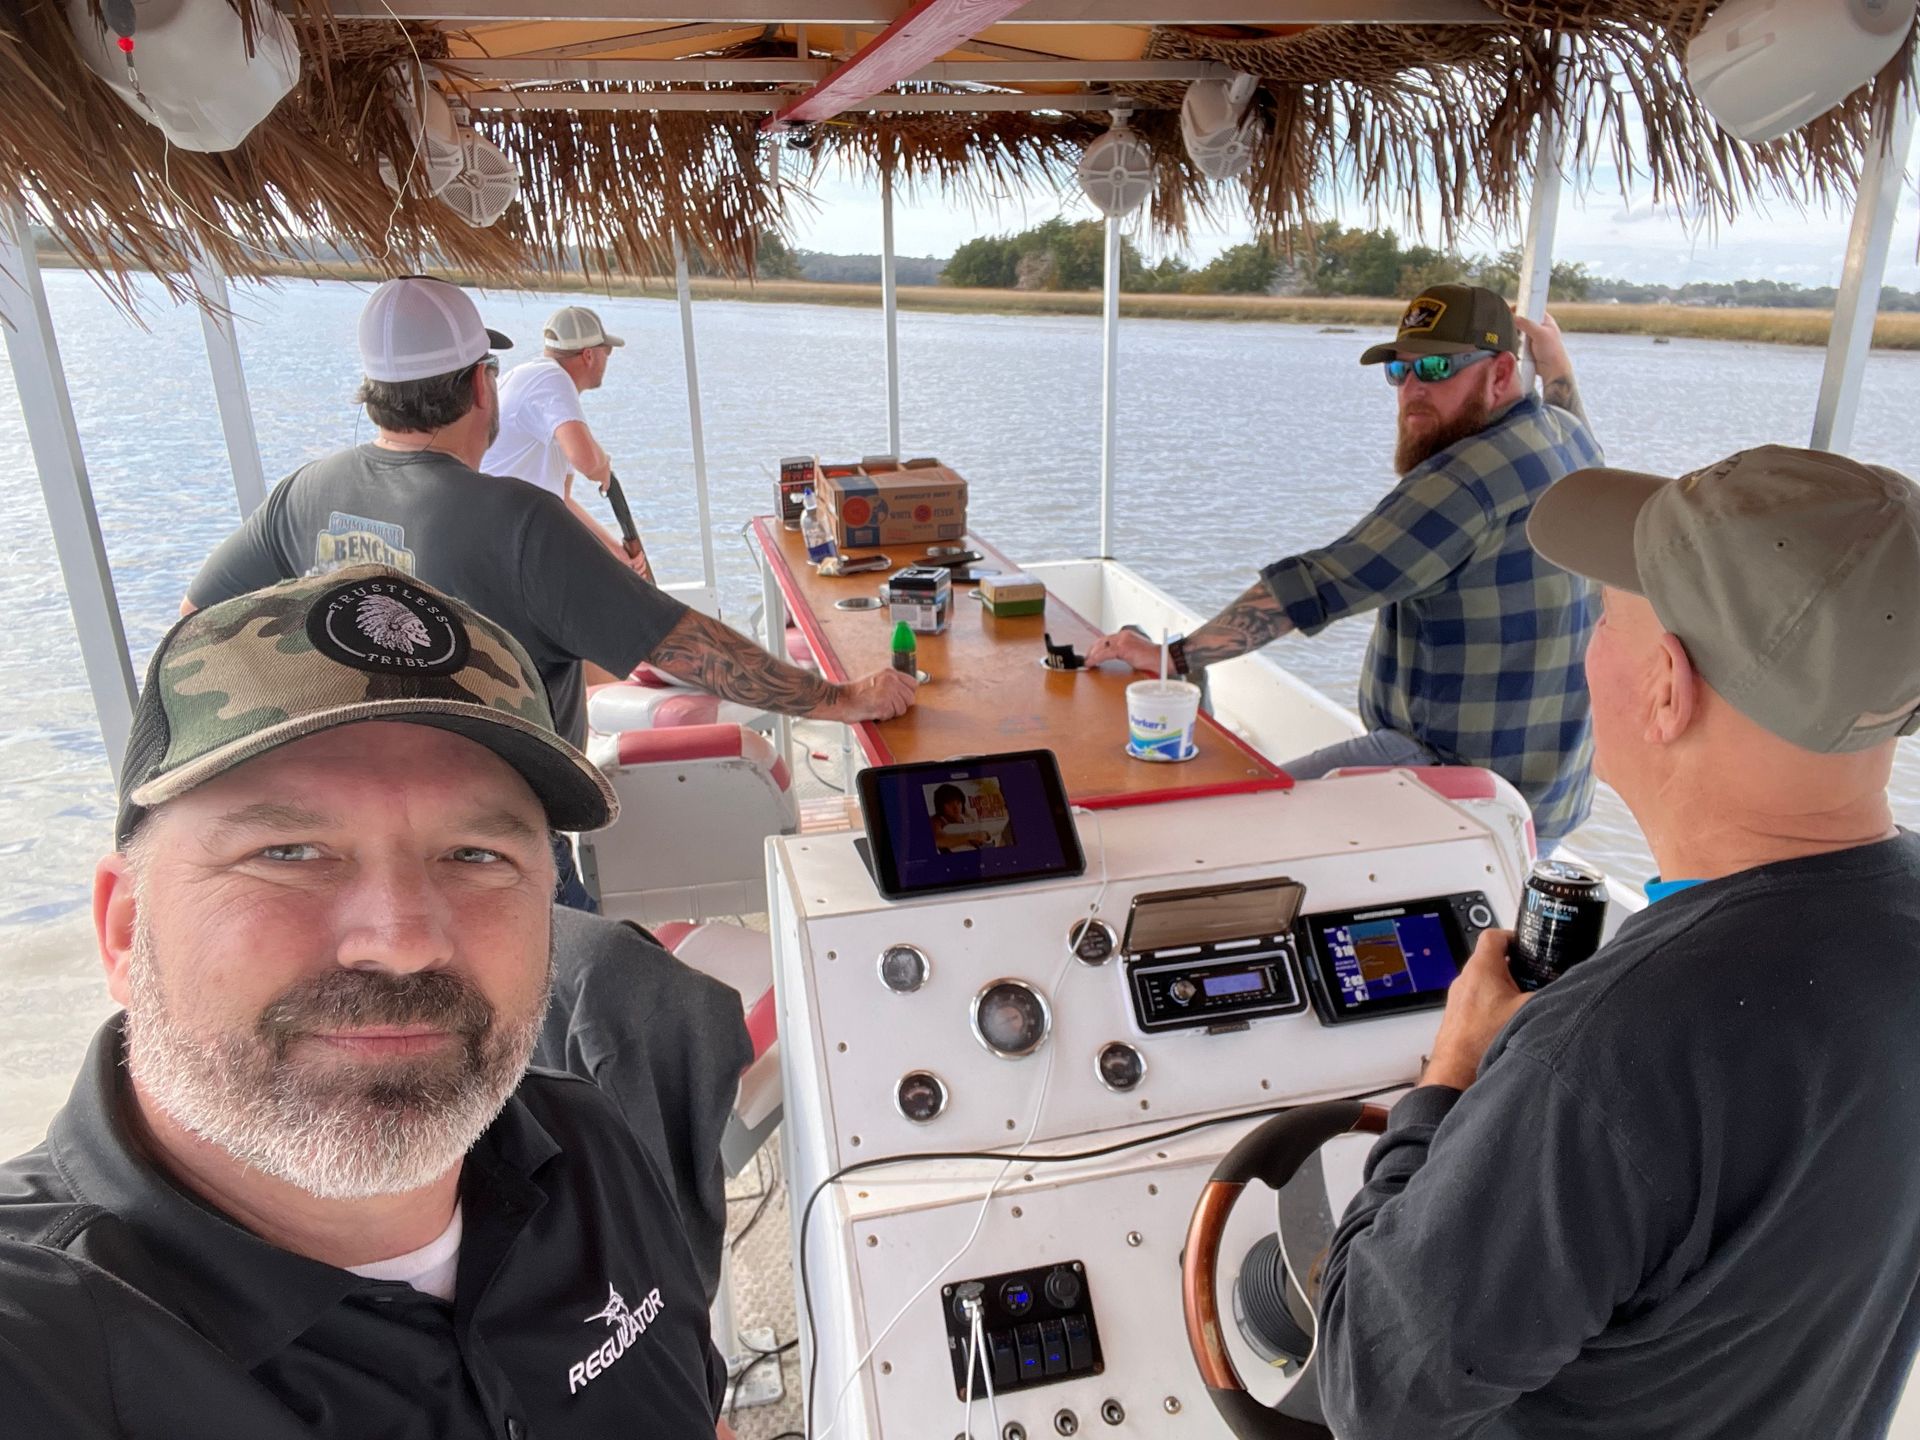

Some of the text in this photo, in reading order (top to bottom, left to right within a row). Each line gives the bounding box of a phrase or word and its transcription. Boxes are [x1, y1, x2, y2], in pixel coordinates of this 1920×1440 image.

[334, 535, 395, 566] BENCH
[328, 583, 449, 624] TRUSTLESS
[366, 653, 429, 669] TRIBE
[568, 1287, 665, 1395] REGULATOR
